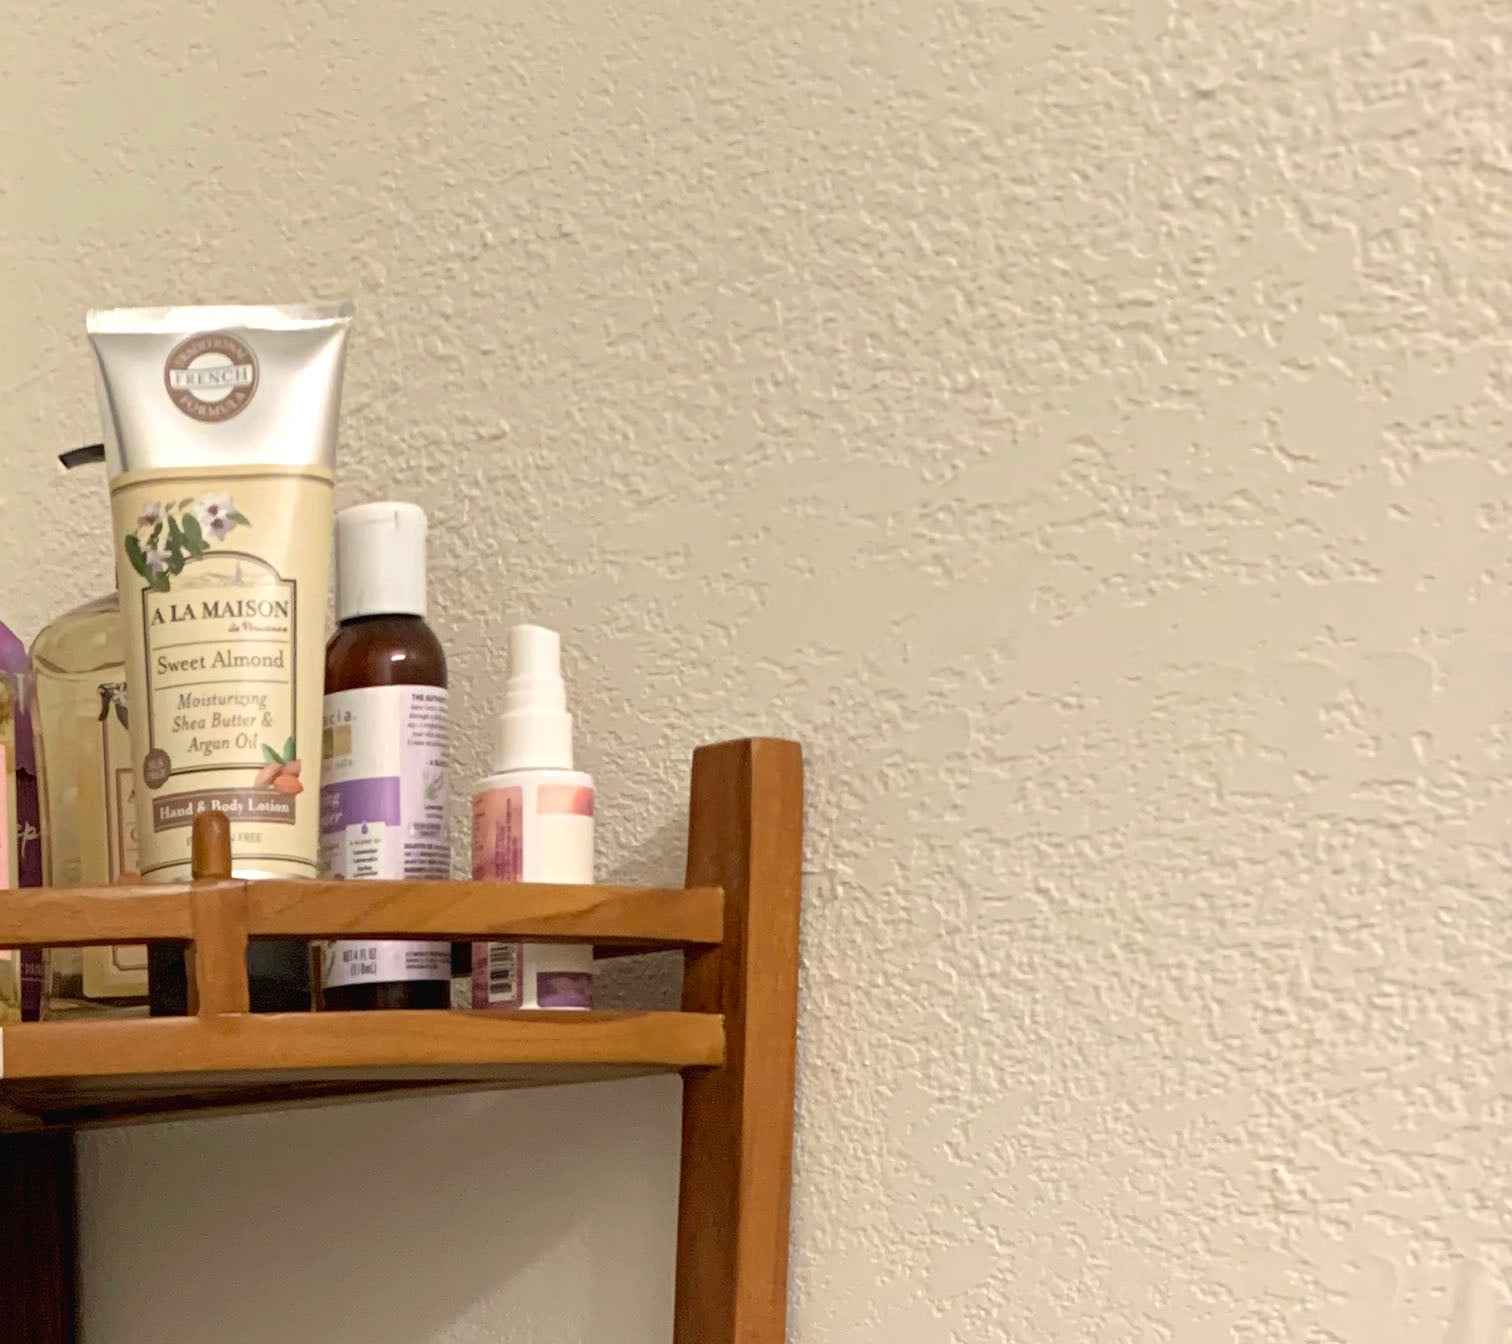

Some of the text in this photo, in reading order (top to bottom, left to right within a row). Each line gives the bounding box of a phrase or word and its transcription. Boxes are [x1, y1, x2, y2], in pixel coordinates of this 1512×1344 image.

[151, 600, 289, 626] A LA MAISON
[157, 649, 285, 676] Sweet Almond
[176, 692, 269, 711] Moisturizing
[172, 711, 272, 734] Shea Butter &
[188, 732, 258, 756] Argan Oil
[159, 804, 194, 821] Hand
[248, 798, 290, 813] Lotion
